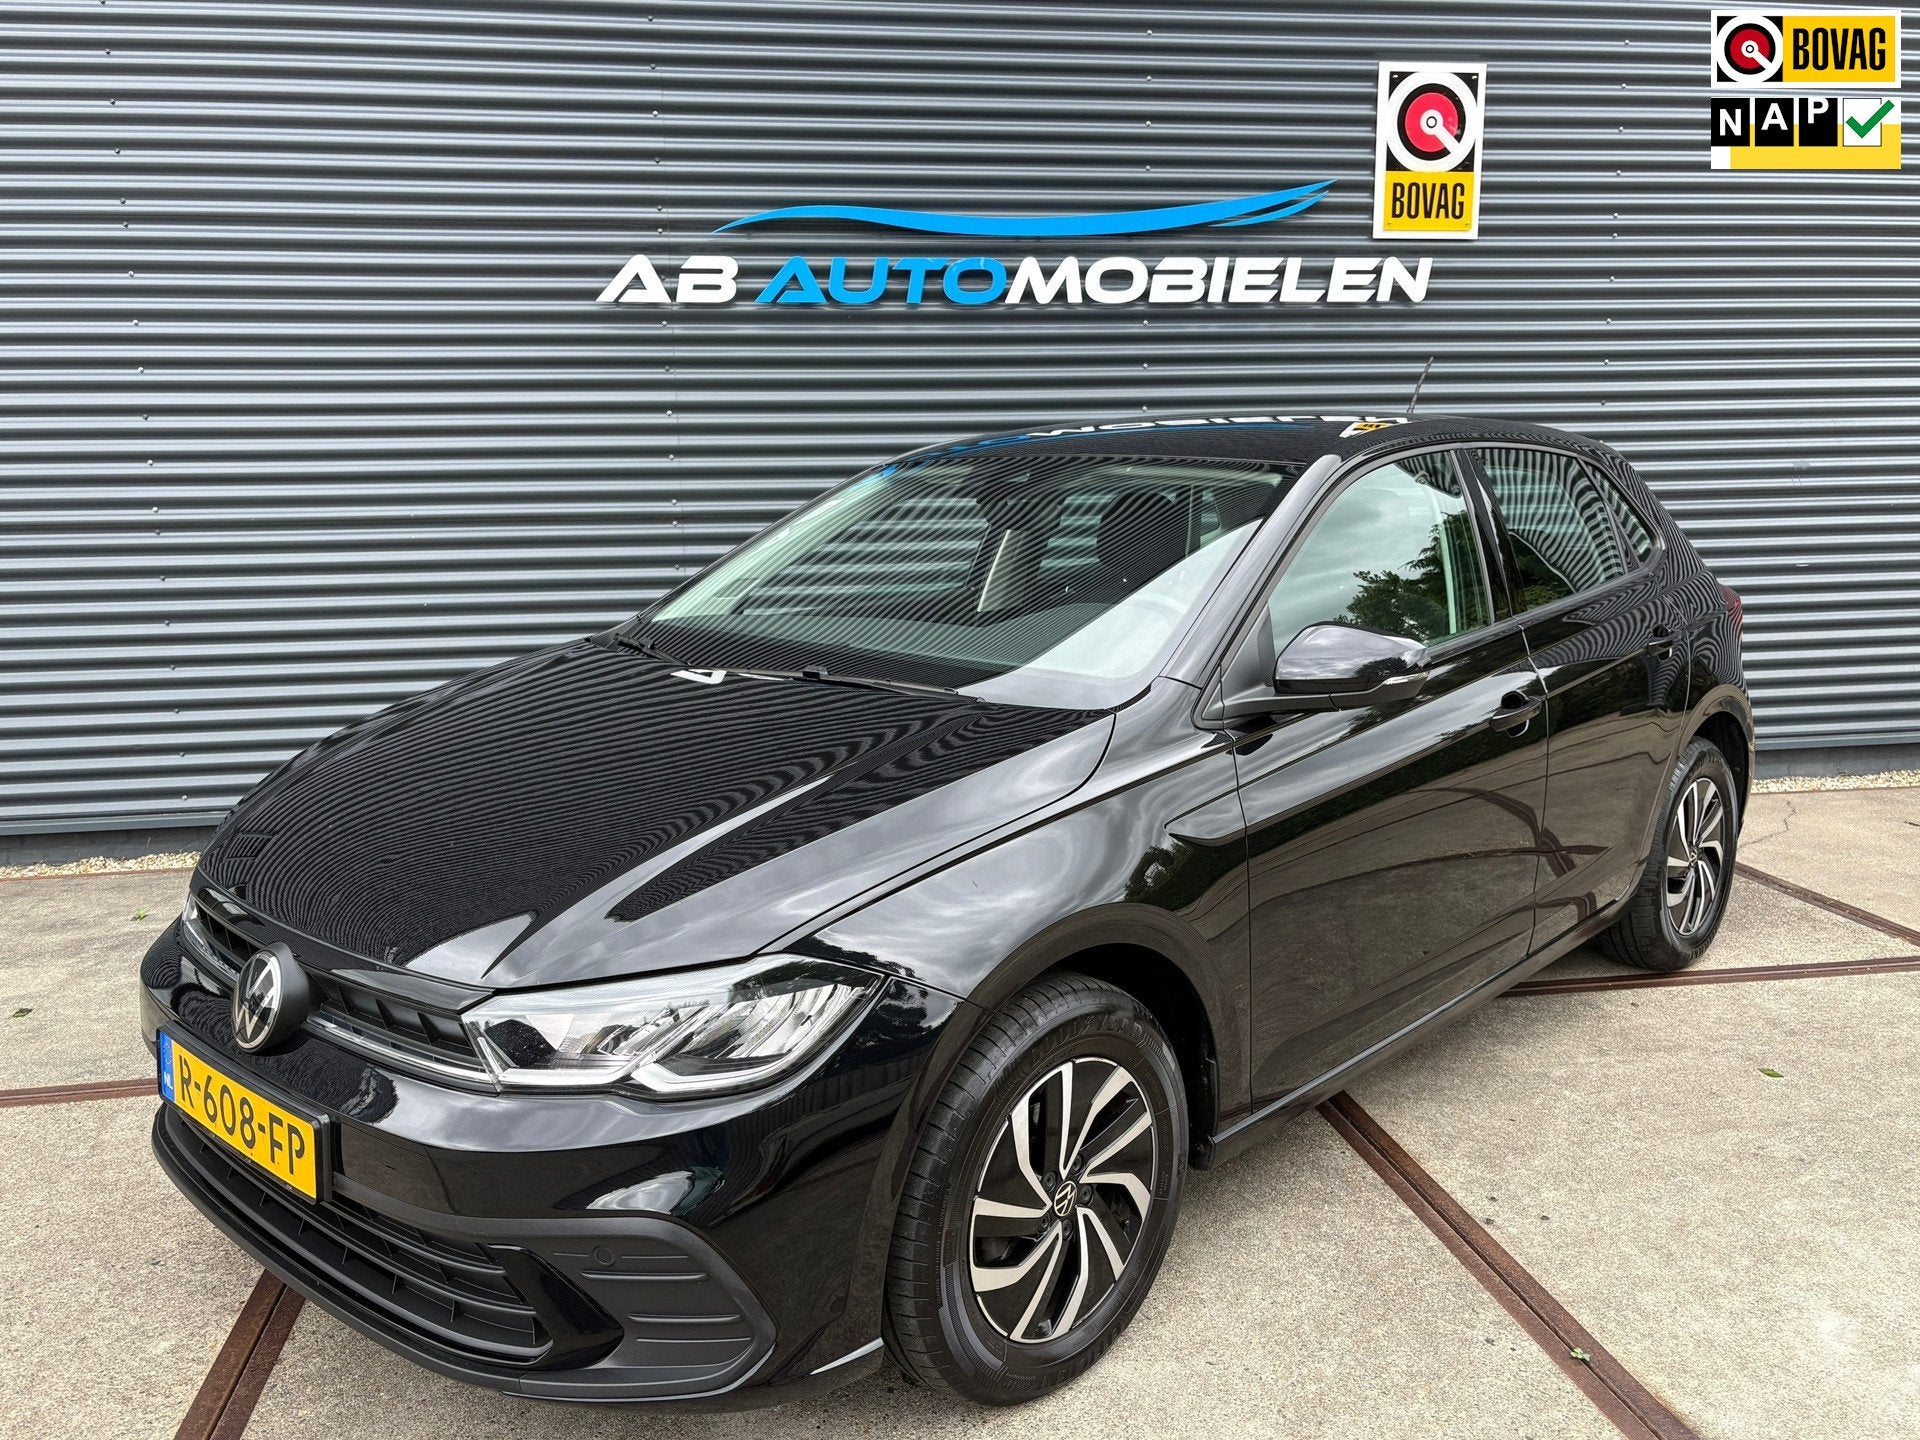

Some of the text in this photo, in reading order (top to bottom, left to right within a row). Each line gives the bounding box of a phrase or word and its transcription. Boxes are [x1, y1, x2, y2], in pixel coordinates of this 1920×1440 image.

[1391, 182, 1465, 220] BOVAG
[595, 253, 1434, 304] AB AUTOMOBIELEN
[178, 1054, 306, 1176] R-608-FP
